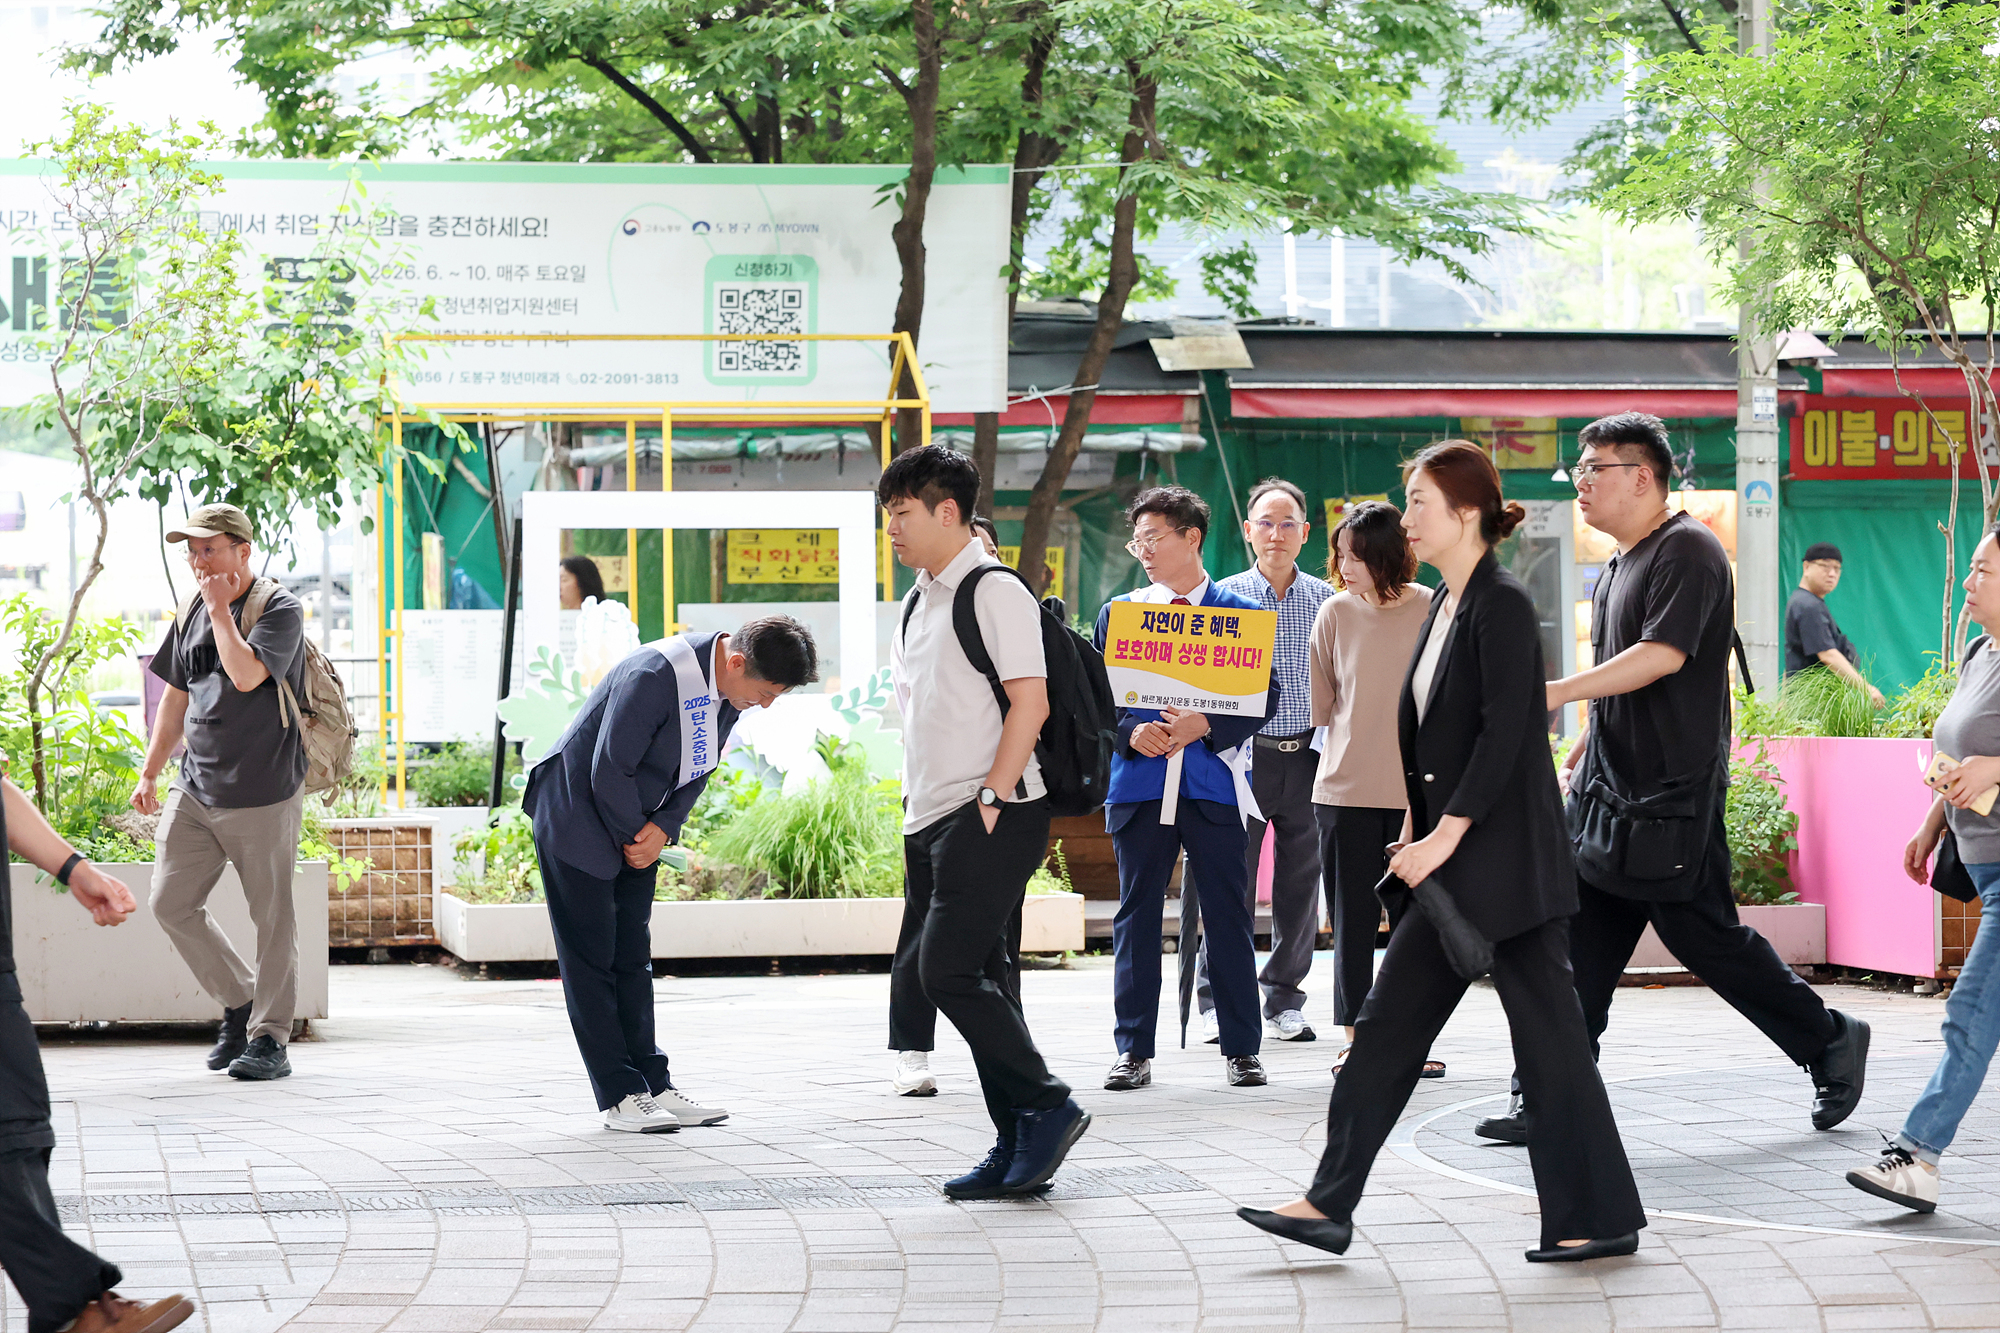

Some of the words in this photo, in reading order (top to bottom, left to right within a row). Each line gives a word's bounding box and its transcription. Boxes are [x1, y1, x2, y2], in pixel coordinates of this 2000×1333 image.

[274, 213, 319, 236] 취업
[427, 215, 548, 238] 충전하세요!
[716, 223, 751, 234] 도봉구
[427, 264, 443, 280] 6.
[466, 265, 491, 281] 10.
[497, 264, 530, 283] 매주
[535, 264, 586, 283] 토요일
[735, 263, 793, 277] 신청하기
[443, 296, 578, 316] 청년취업지원센터
[459, 371, 496, 384] 도봉구
[500, 371, 560, 385] 청년미래과
[579, 373, 680, 385] 02-2091-3813
[1746, 506, 1771, 518] 도봉구
[1140, 611, 1185, 635] 자연이
[1190, 614, 1205, 636] 준
[1209, 615, 1242, 639] 혜택,
[1115, 638, 1174, 664] 보호하며
[1178, 642, 1208, 666] 상생
[1212, 645, 1263, 669] 합시다!
[684, 695, 711, 710] 2025
[1141, 694, 1191, 707] 바르게살기운동
[1192, 699, 1239, 710] 도봉1동위원회
[691, 710, 708, 766] 탄소중립
